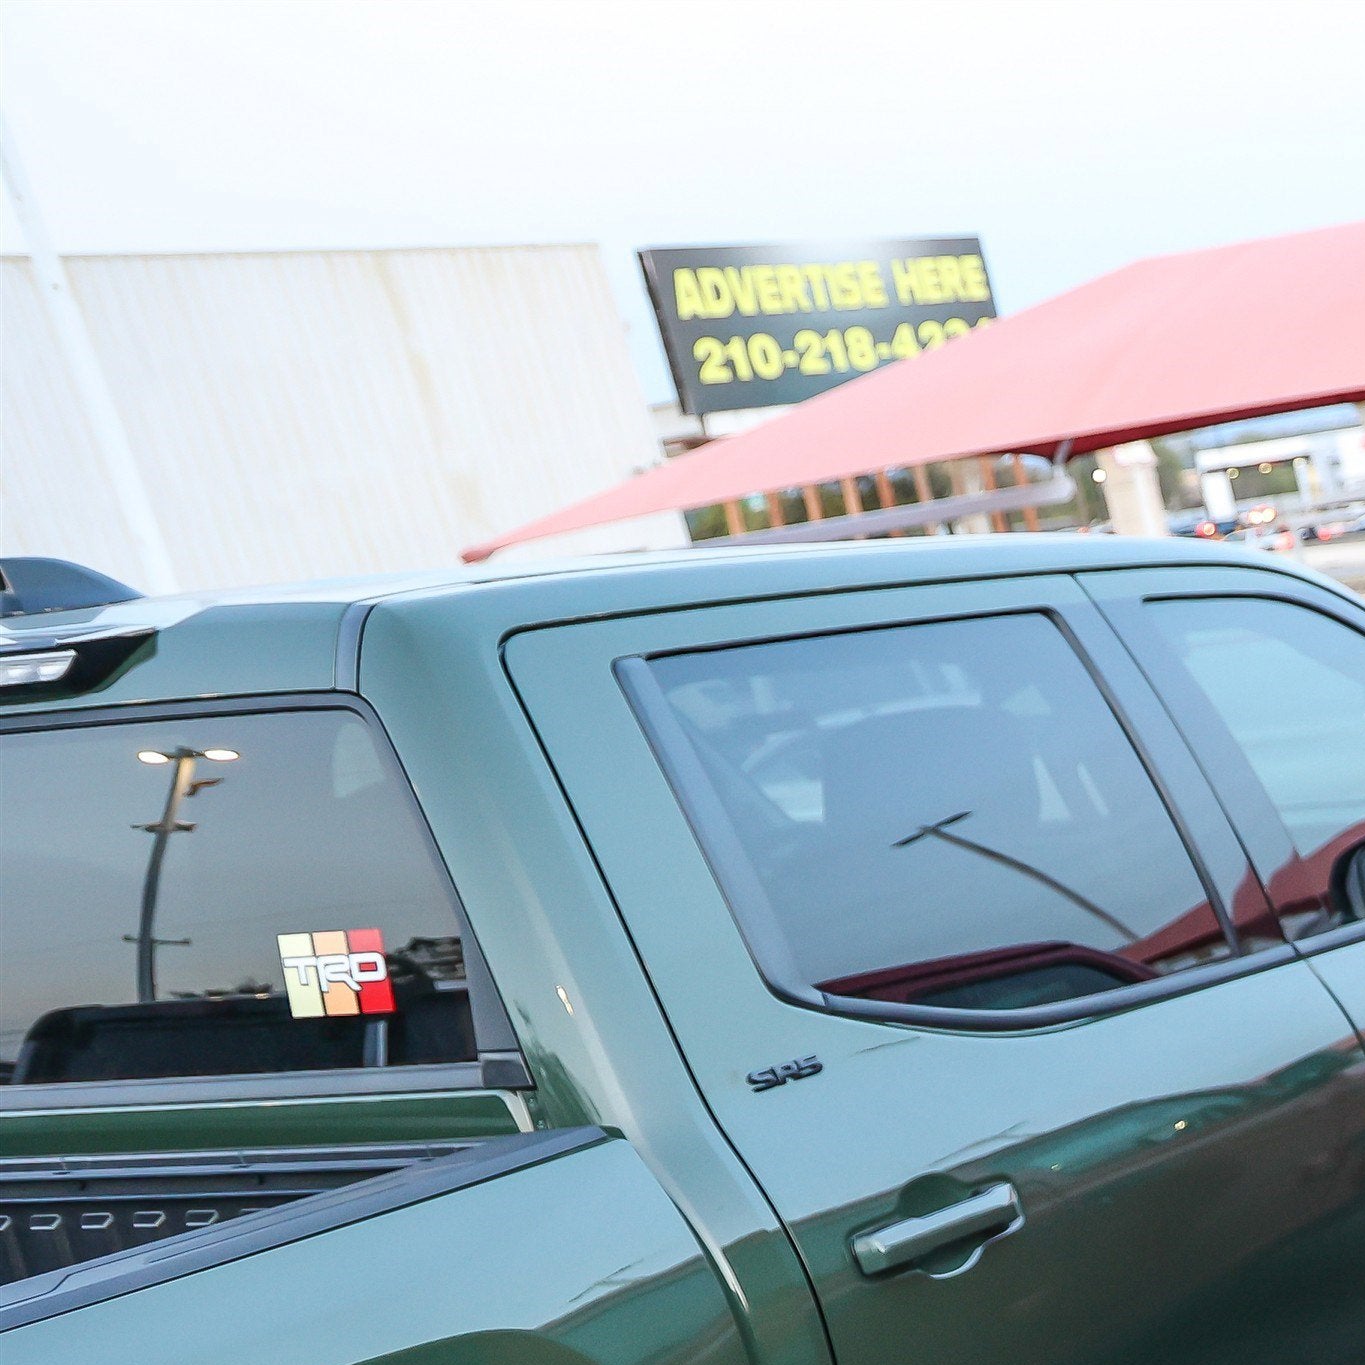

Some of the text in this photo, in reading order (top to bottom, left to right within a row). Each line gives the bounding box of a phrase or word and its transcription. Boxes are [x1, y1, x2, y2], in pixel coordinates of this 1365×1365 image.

[673, 254, 990, 320] ADVERTISE HERE
[692, 316, 992, 385] 210-218-42
[283, 951, 387, 993] TRD
[745, 1055, 823, 1092] SR5
